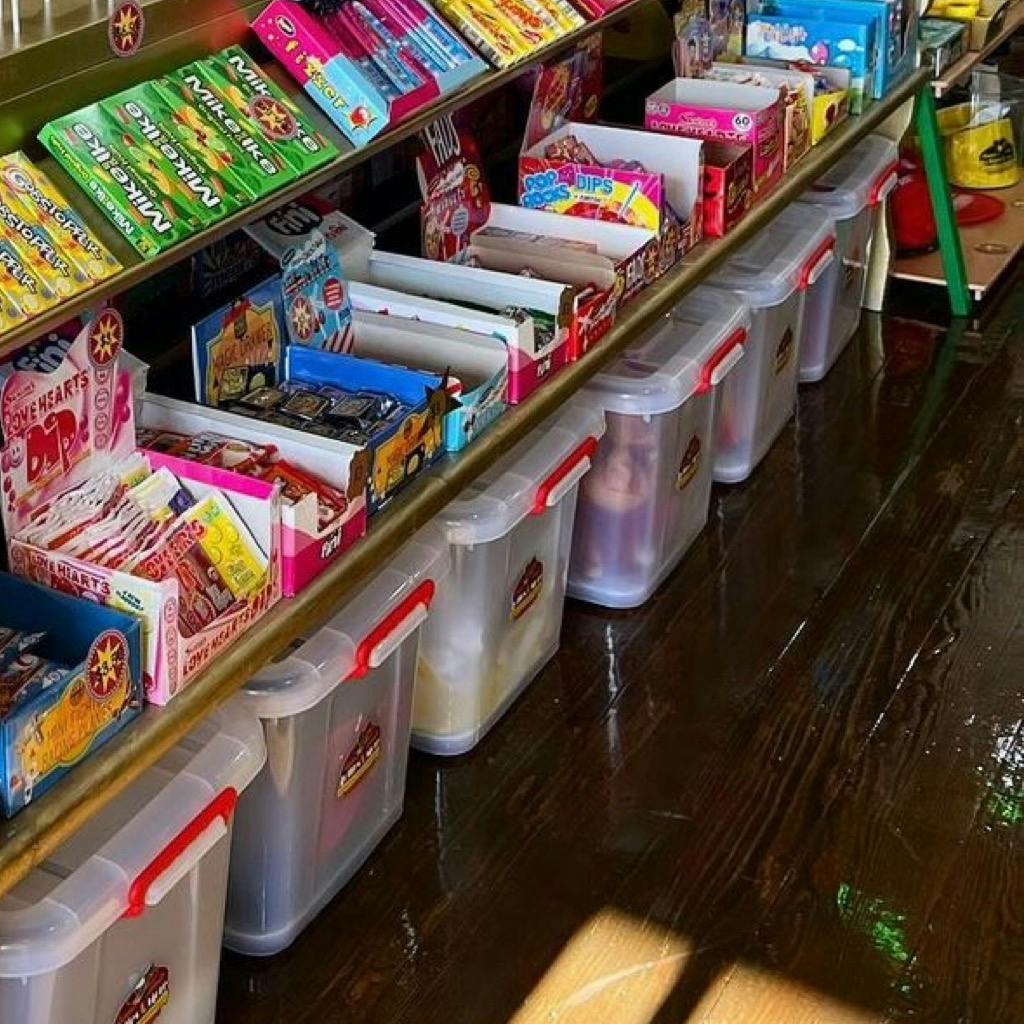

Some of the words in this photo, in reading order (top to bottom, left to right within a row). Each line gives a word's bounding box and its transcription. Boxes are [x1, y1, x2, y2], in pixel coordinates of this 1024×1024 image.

[229, 53, 272, 98] Mik
[576, 175, 613, 194] DIPS
[37, 369, 89, 414] HEARTS
